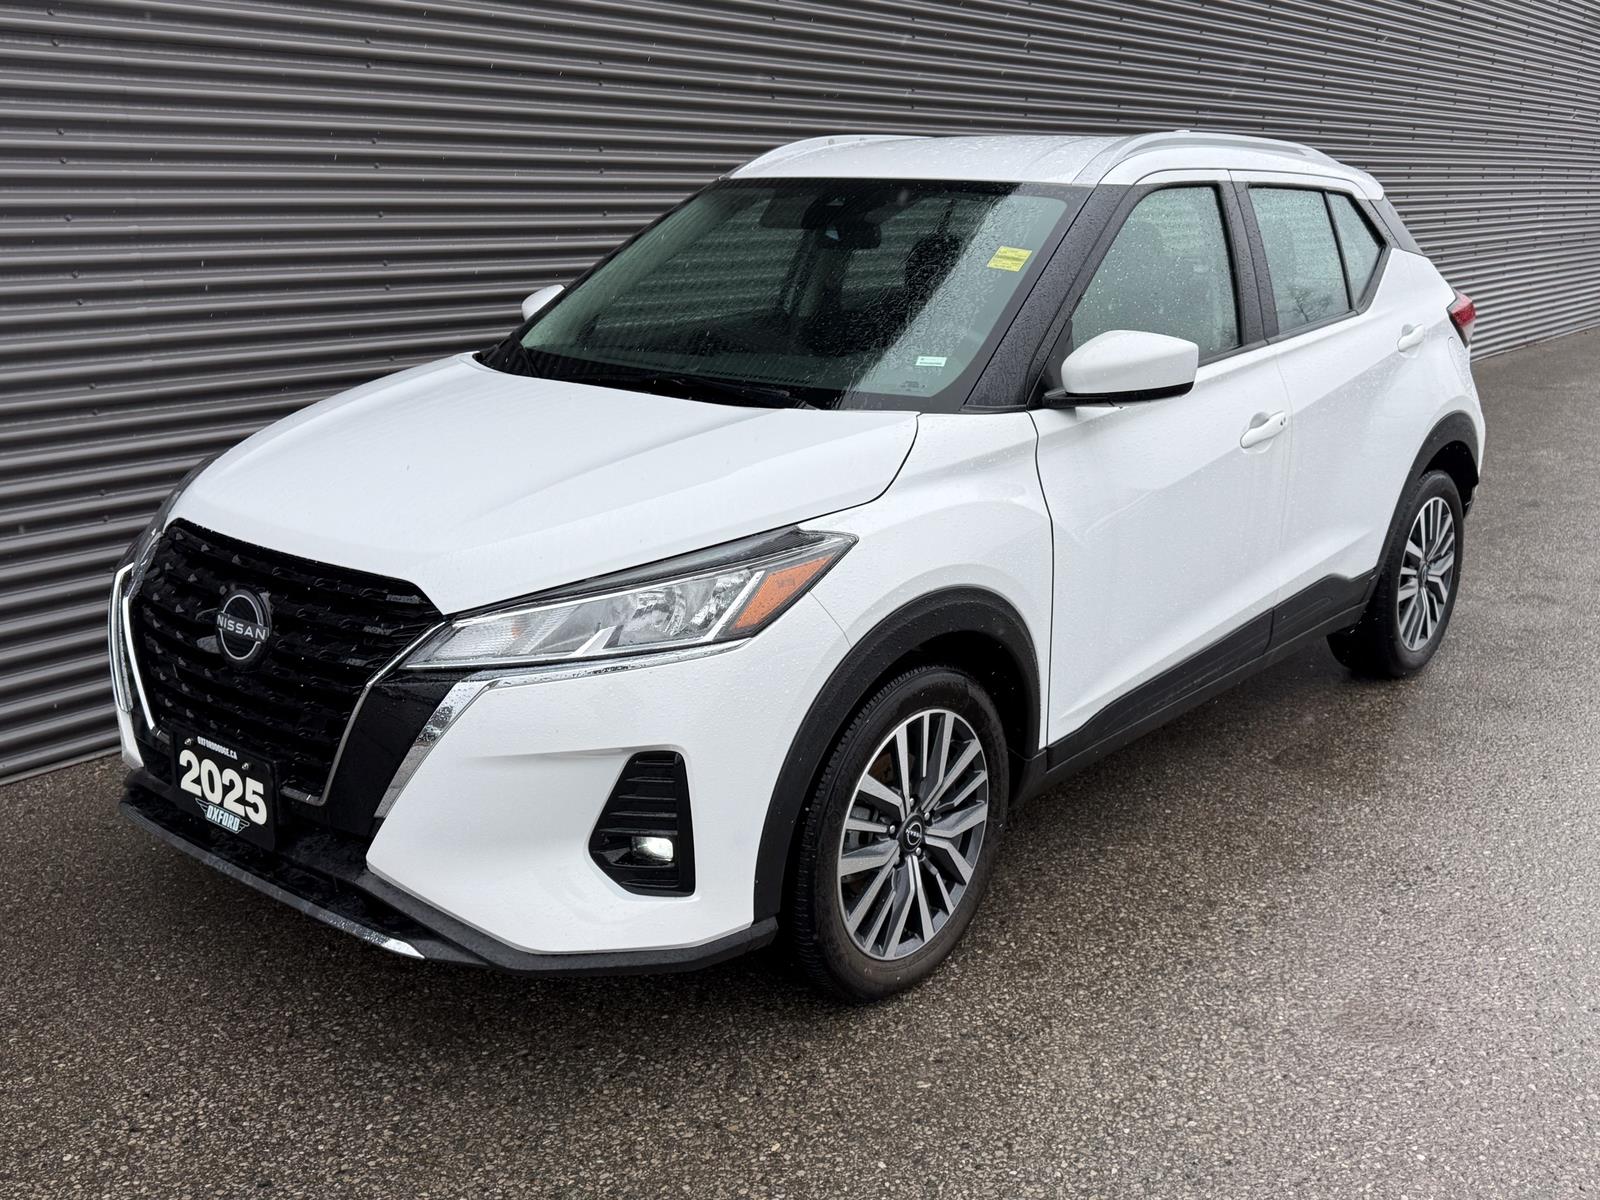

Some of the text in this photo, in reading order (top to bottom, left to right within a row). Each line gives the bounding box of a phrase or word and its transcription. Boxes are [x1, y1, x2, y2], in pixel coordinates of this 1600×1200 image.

[217, 614, 266, 641] NISSAN
[179, 749, 267, 826] 2025
[206, 804, 241, 832] OXFORD
